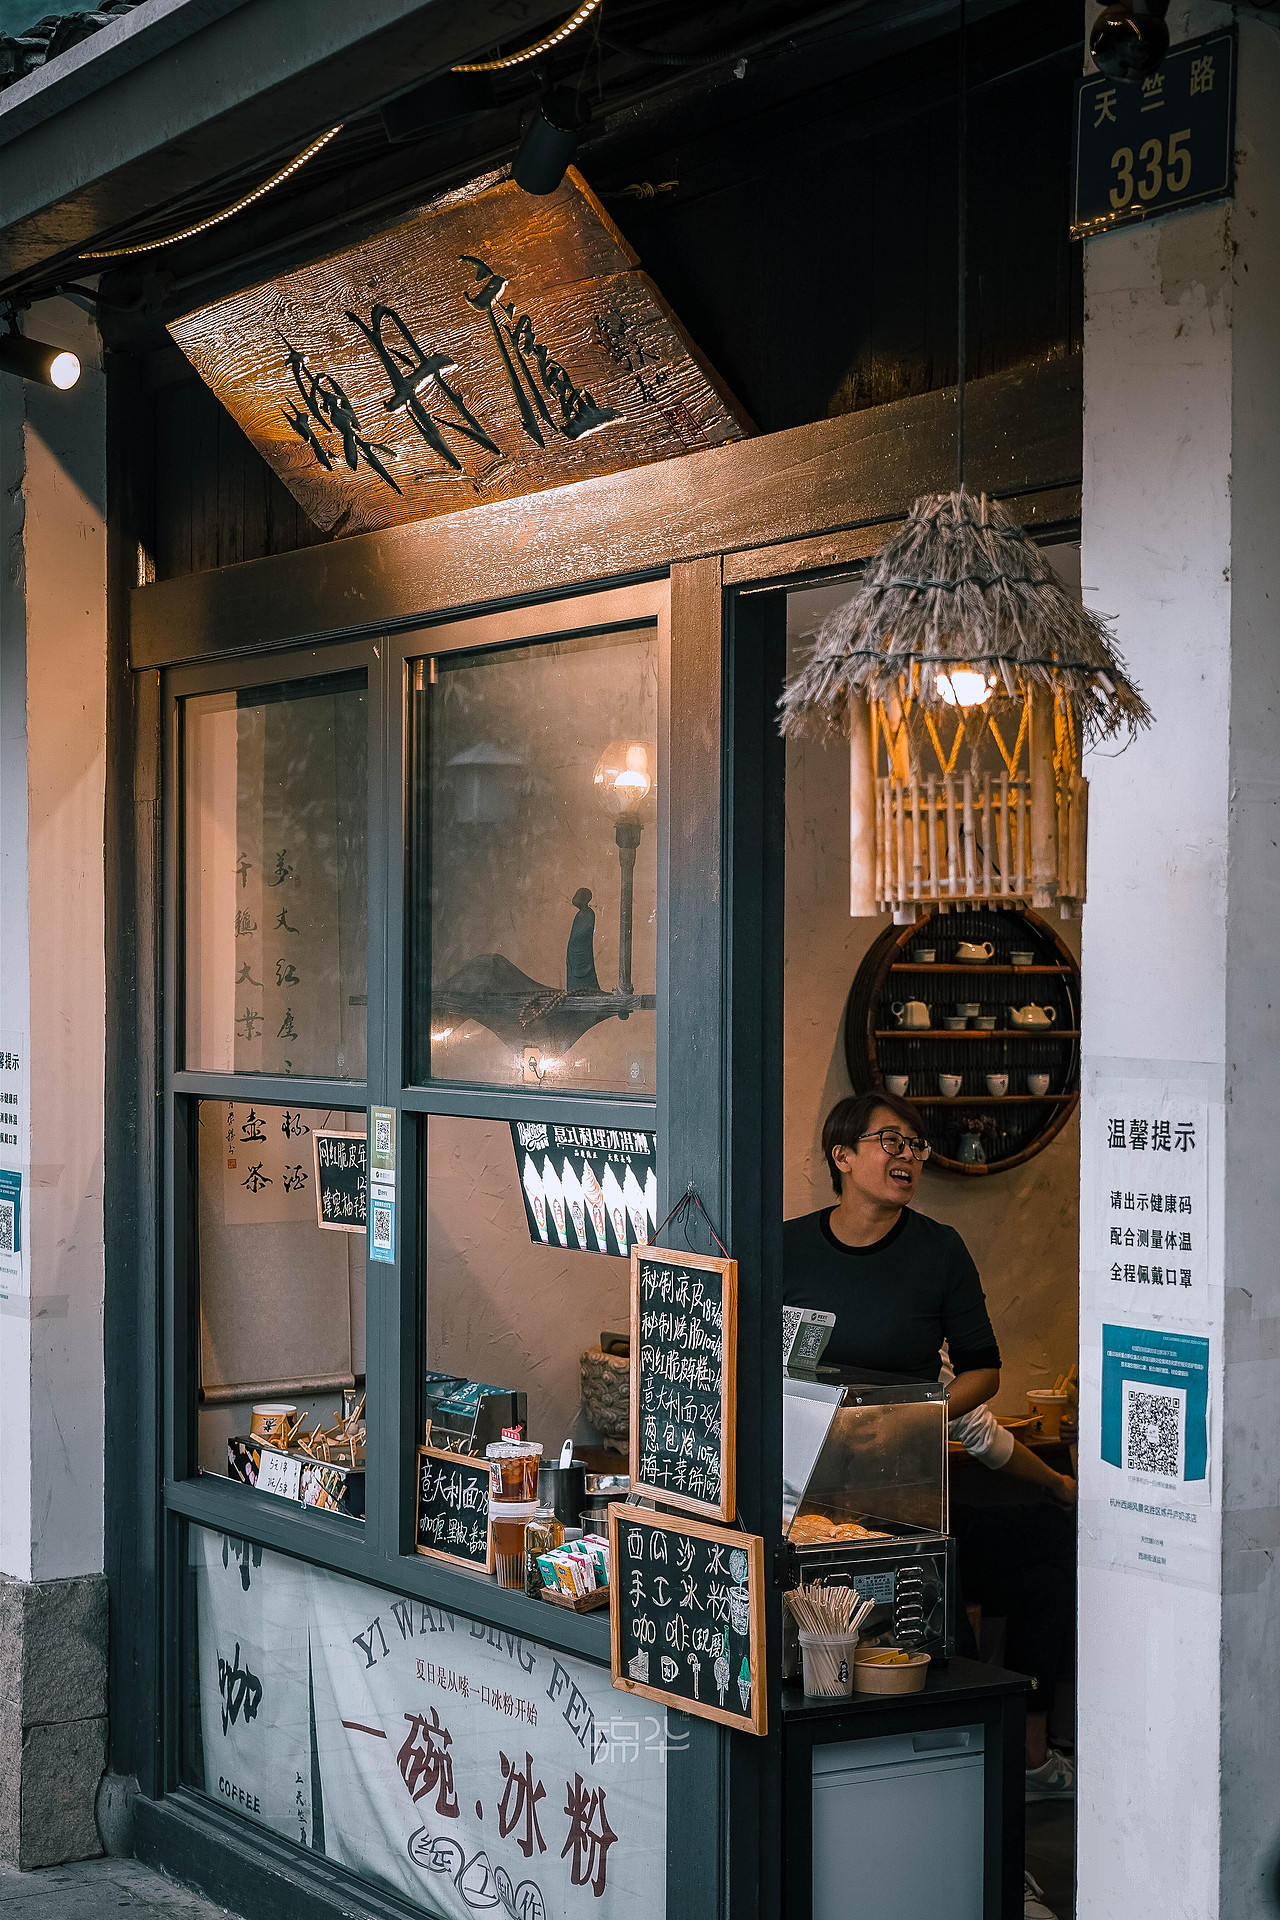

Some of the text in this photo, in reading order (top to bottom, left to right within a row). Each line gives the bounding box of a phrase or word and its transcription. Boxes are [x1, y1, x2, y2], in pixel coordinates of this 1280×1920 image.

[1093, 55, 1215, 128] 天竺路
[1109, 128, 1192, 209] 335
[1107, 1118, 1195, 1152] 温馨提示
[1110, 1190, 1192, 1214] 请出示健康码
[1110, 1226, 1192, 1251] 配合测量体温
[641, 1265, 704, 1314] 秘制凉皮
[1110, 1262, 1192, 1288] 全程佩戴口罩
[641, 1311, 704, 1350] 秘制烤肠
[641, 1373, 698, 1424] 意大利面
[645, 1414, 697, 1459] 葱包烩
[420, 1458, 478, 1511] 意大利面
[640, 1453, 704, 1497] 梅干菜饼
[627, 1528, 730, 1576] 西瓜沙冰
[628, 1569, 731, 1623] 手工冰粉
[352, 1617, 390, 1669] YI
[546, 1657, 608, 1765] FEN
[415, 1657, 538, 1727] 夏日是从嗦一口冰粉开始
[218, 1776, 261, 1815] COFFEE
